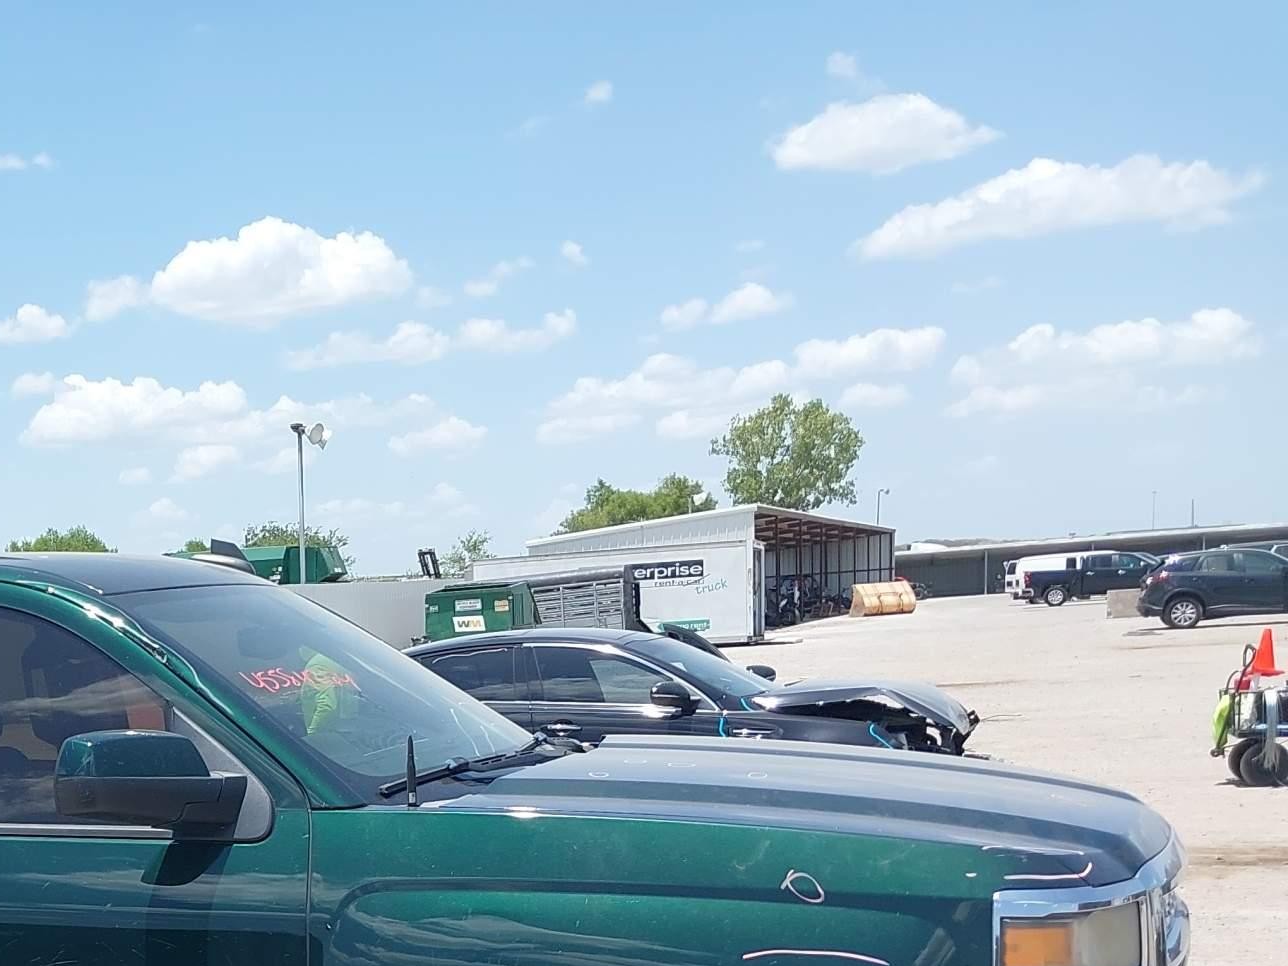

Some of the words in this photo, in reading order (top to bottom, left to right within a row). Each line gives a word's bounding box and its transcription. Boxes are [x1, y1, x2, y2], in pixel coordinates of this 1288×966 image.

[633, 563, 703, 580] erprise
[696, 578, 727, 594] truck
[457, 620, 481, 628] WM
